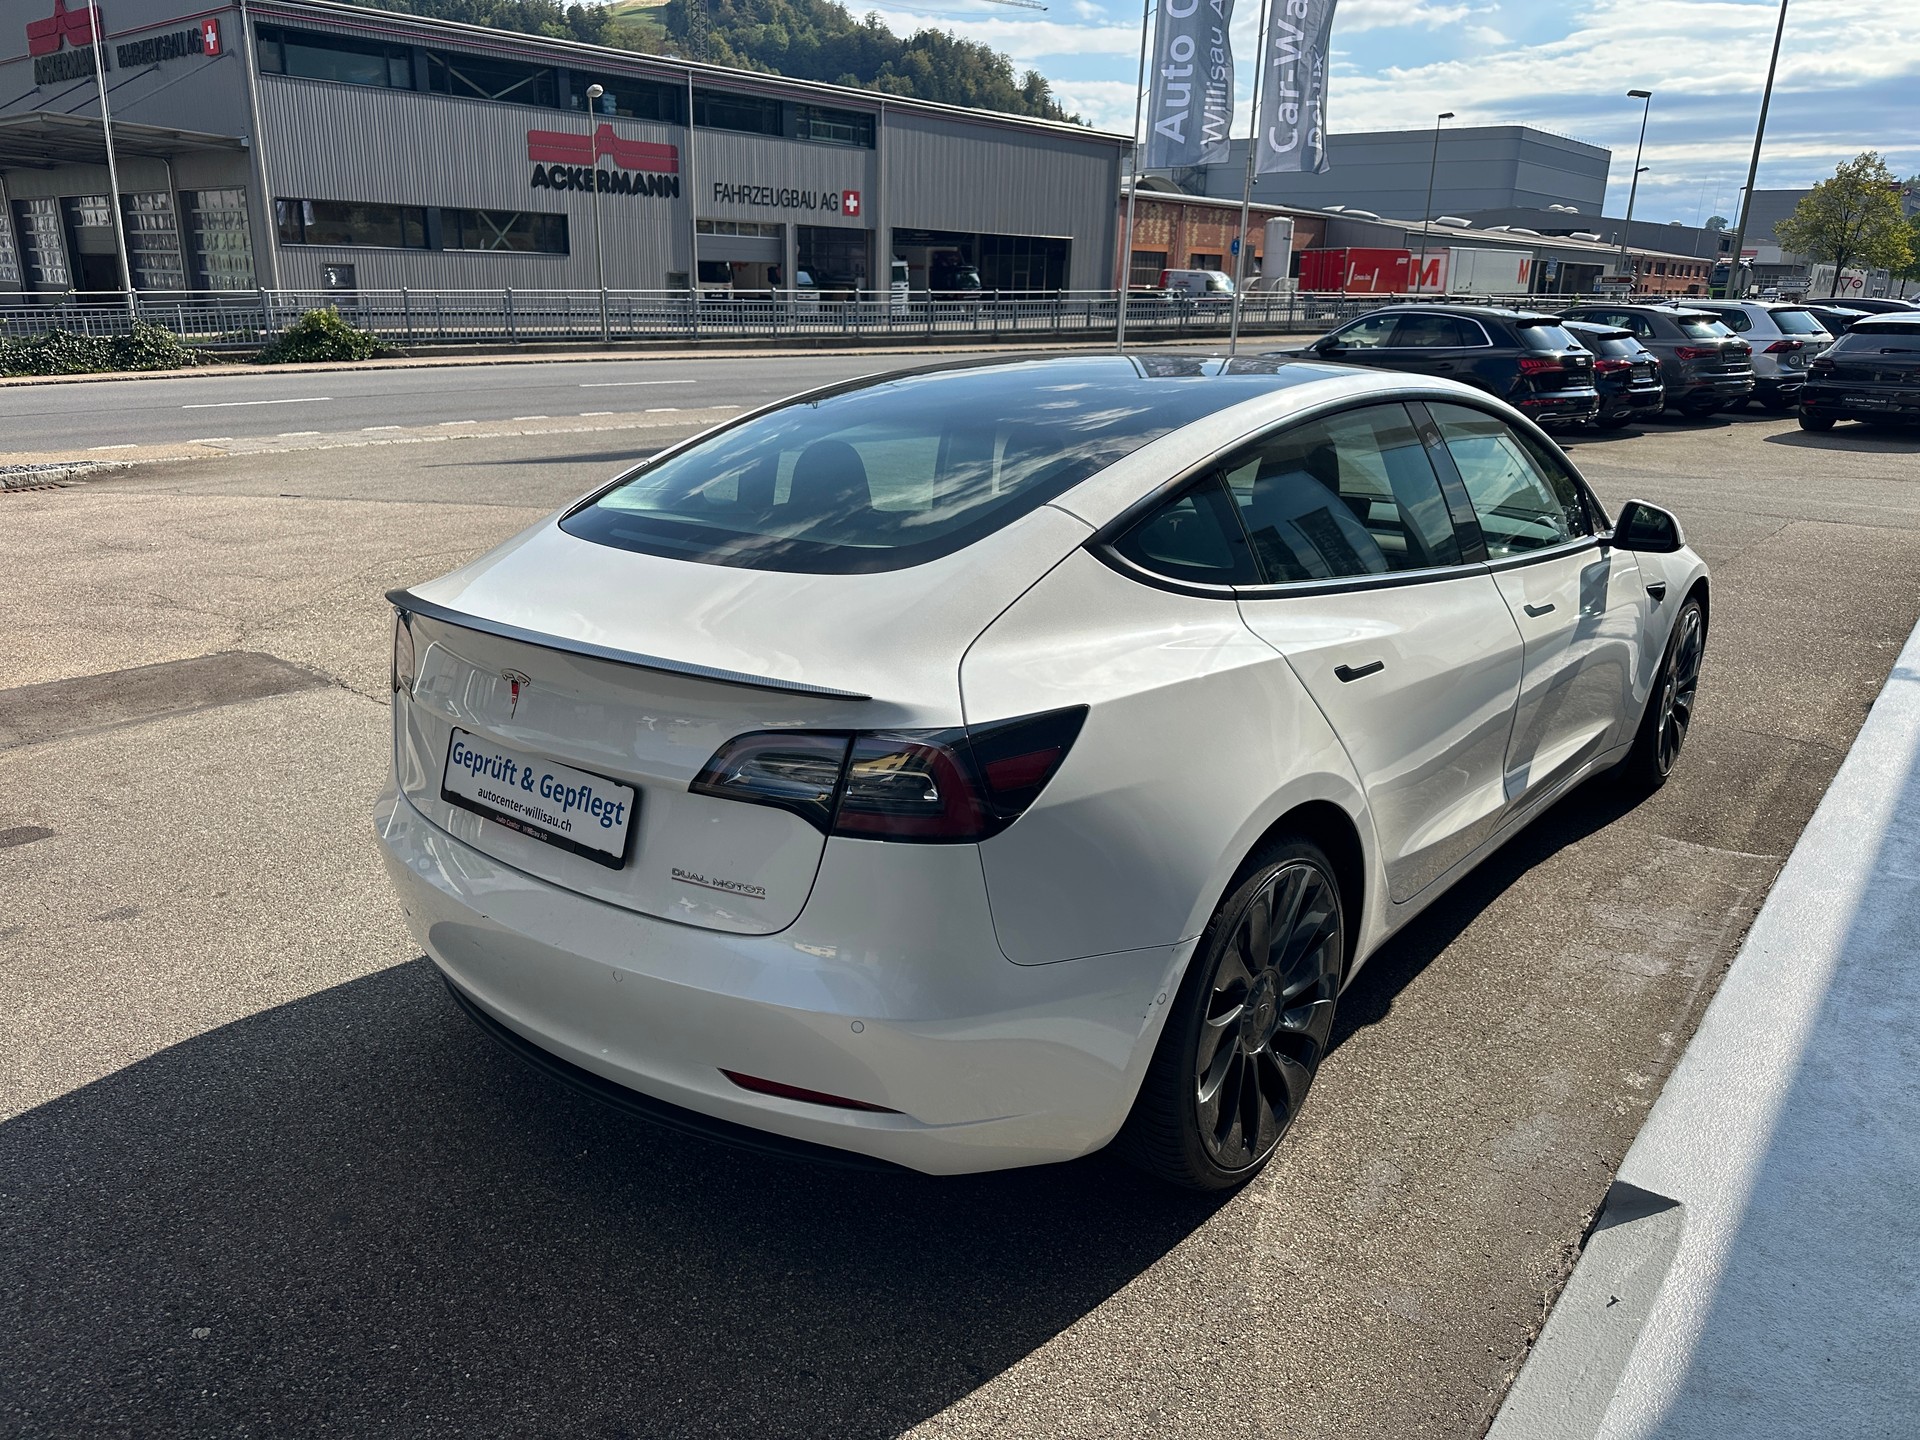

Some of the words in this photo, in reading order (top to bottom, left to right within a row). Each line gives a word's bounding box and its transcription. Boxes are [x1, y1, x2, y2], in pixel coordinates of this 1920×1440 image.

[1155, 34, 1196, 144] Auto
[1200, 26, 1227, 146] Willisau
[1268, 0, 1308, 153] Car-Wa
[530, 163, 680, 199] ACKERMANN
[713, 182, 817, 210] FAHRZEUGBAU
[820, 191, 839, 212] AG
[1518, 259, 1530, 284] M
[452, 742, 518, 786] Geprüft
[520, 767, 535, 793] &
[539, 774, 625, 829] Gepflegt
[477, 787, 572, 833] autocenter-willisau.ch
[671, 867, 709, 885] DUAL
[712, 878, 766, 896] MOTOR
